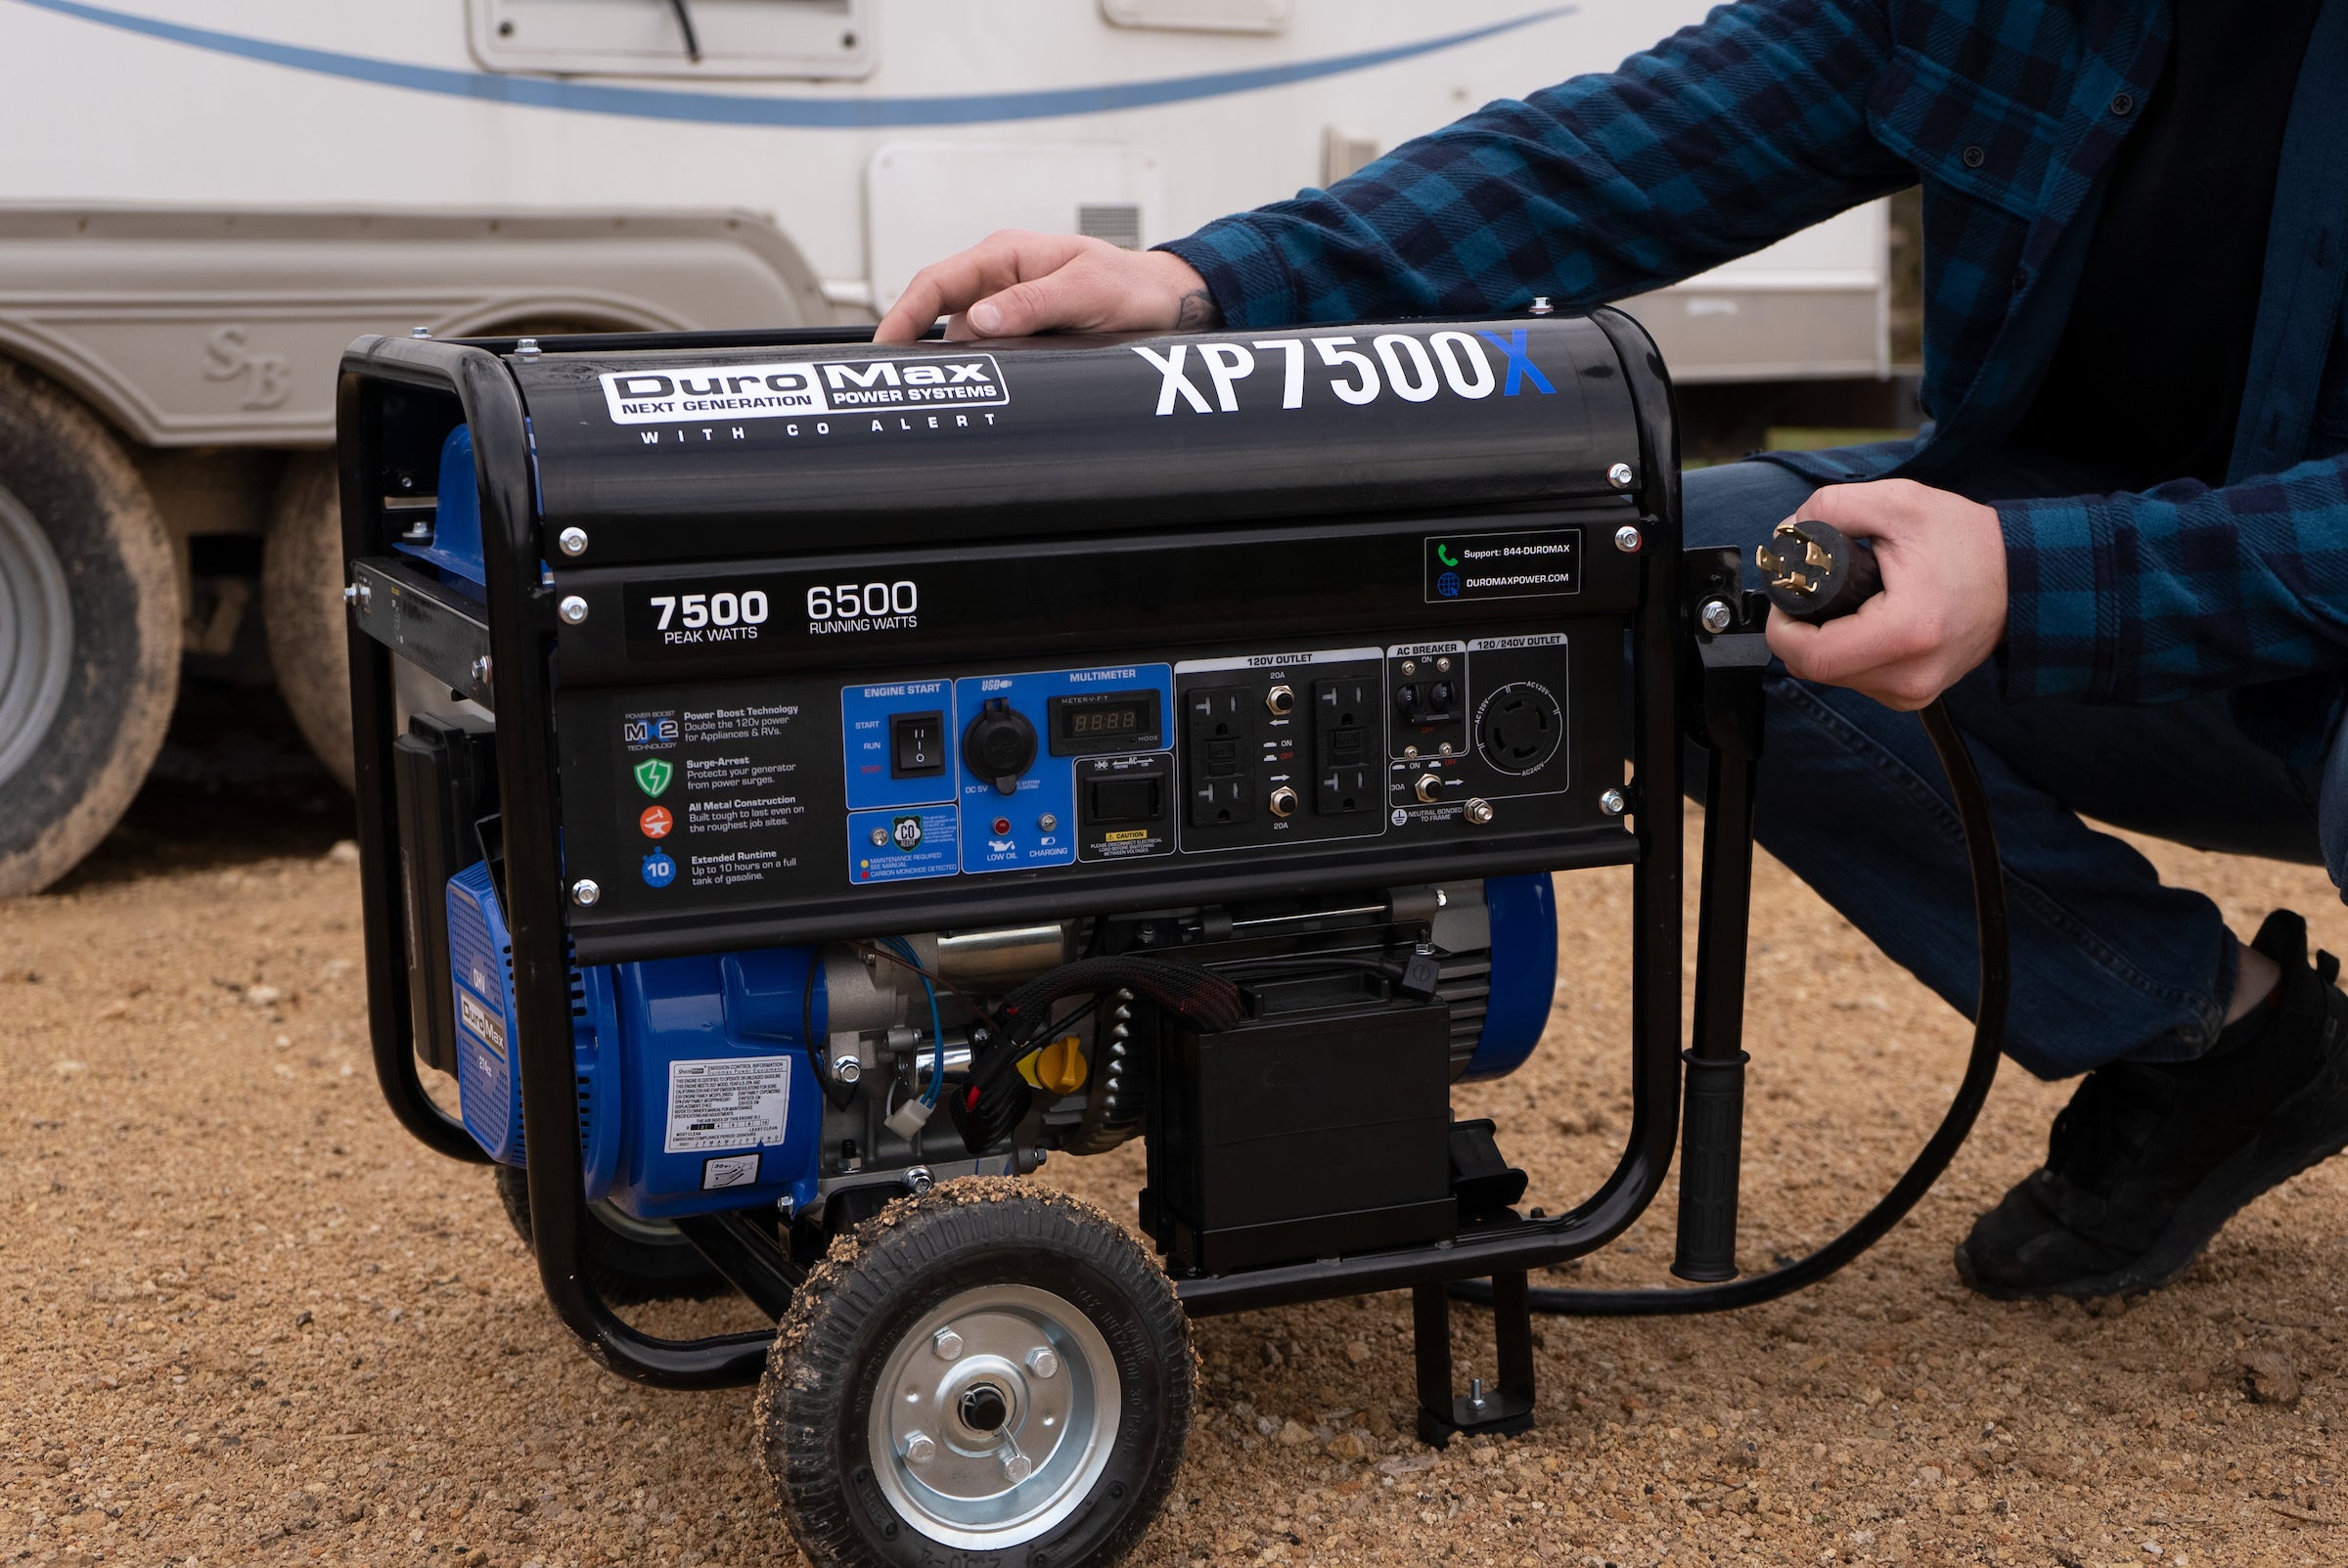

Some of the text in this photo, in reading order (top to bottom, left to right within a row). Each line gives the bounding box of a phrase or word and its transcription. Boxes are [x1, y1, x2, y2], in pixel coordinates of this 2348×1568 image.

[1130, 328, 1558, 416] XP7500X
[833, 383, 998, 405] POWER SYSTEMS
[621, 394, 813, 415] NEXT GENERATION
[640, 412, 996, 444] WITH CO ALERT
[1464, 544, 1570, 560] Support: 844-DUROMAX
[1466, 573, 1569, 588] DUROMAXPOWER.COM
[807, 580, 918, 620] 6500
[650, 590, 769, 631] 7500
[809, 615, 918, 635] RUNNING WATTS
[664, 626, 758, 645] PEAK WATTS
[1476, 635, 1562, 650] 120/240V OUTLET
[1396, 643, 1458, 656] AC BREAKER
[1247, 653, 1313, 666] 120V OUTLET
[1069, 669, 1136, 683] MULTIMETER
[864, 684, 941, 697] ENGINE START
[981, 680, 1000, 692] USB
[1525, 680, 1551, 695] AC120V
[625, 709, 675, 720] POWER BOOST
[684, 704, 799, 721] Power Boost Technology
[1473, 697, 1490, 725] AC120V
[685, 716, 790, 732] Double the 120v power
[855, 721, 880, 730] START
[685, 726, 782, 742] for Appliances & RVs.
[626, 741, 677, 751] TECHNOLOGY
[863, 741, 881, 750] RUN
[686, 756, 750, 770] Surge-Arrest
[1128, 756, 1138, 765] AC
[687, 763, 797, 780] Protects your generator
[1521, 761, 1546, 777] AC240V
[687, 776, 775, 791] from power surges.
[688, 796, 796, 812] All Metal Construction
[689, 813, 710, 823] Built
[711, 811, 739, 824] tough
[740, 811, 750, 820] to
[751, 809, 769, 818] last
[770, 808, 791, 817] even
[1408, 806, 1464, 818] NEUTRAL BONDED
[1429, 813, 1452, 822] FRAME
[689, 817, 790, 833] the roughest job sites.
[901, 825, 915, 839] CO
[691, 849, 777, 865] Extended Runtime
[870, 855, 912, 864] MAINTENANCE
[986, 851, 1017, 862] LOW OIL
[1029, 847, 1068, 858] CHARGING
[647, 862, 669, 877] 10
[692, 867, 705, 877] Up
[706, 865, 717, 874] to
[719, 864, 733, 873] 10
[734, 861, 760, 872] hours
[761, 861, 774, 870] on
[783, 858, 797, 867] full
[881, 861, 907, 870] MANUAL
[895, 867, 927, 875] MONOXIDE
[927, 864, 957, 873] DETECTED
[692, 872, 764, 886] tank of gasoline.
